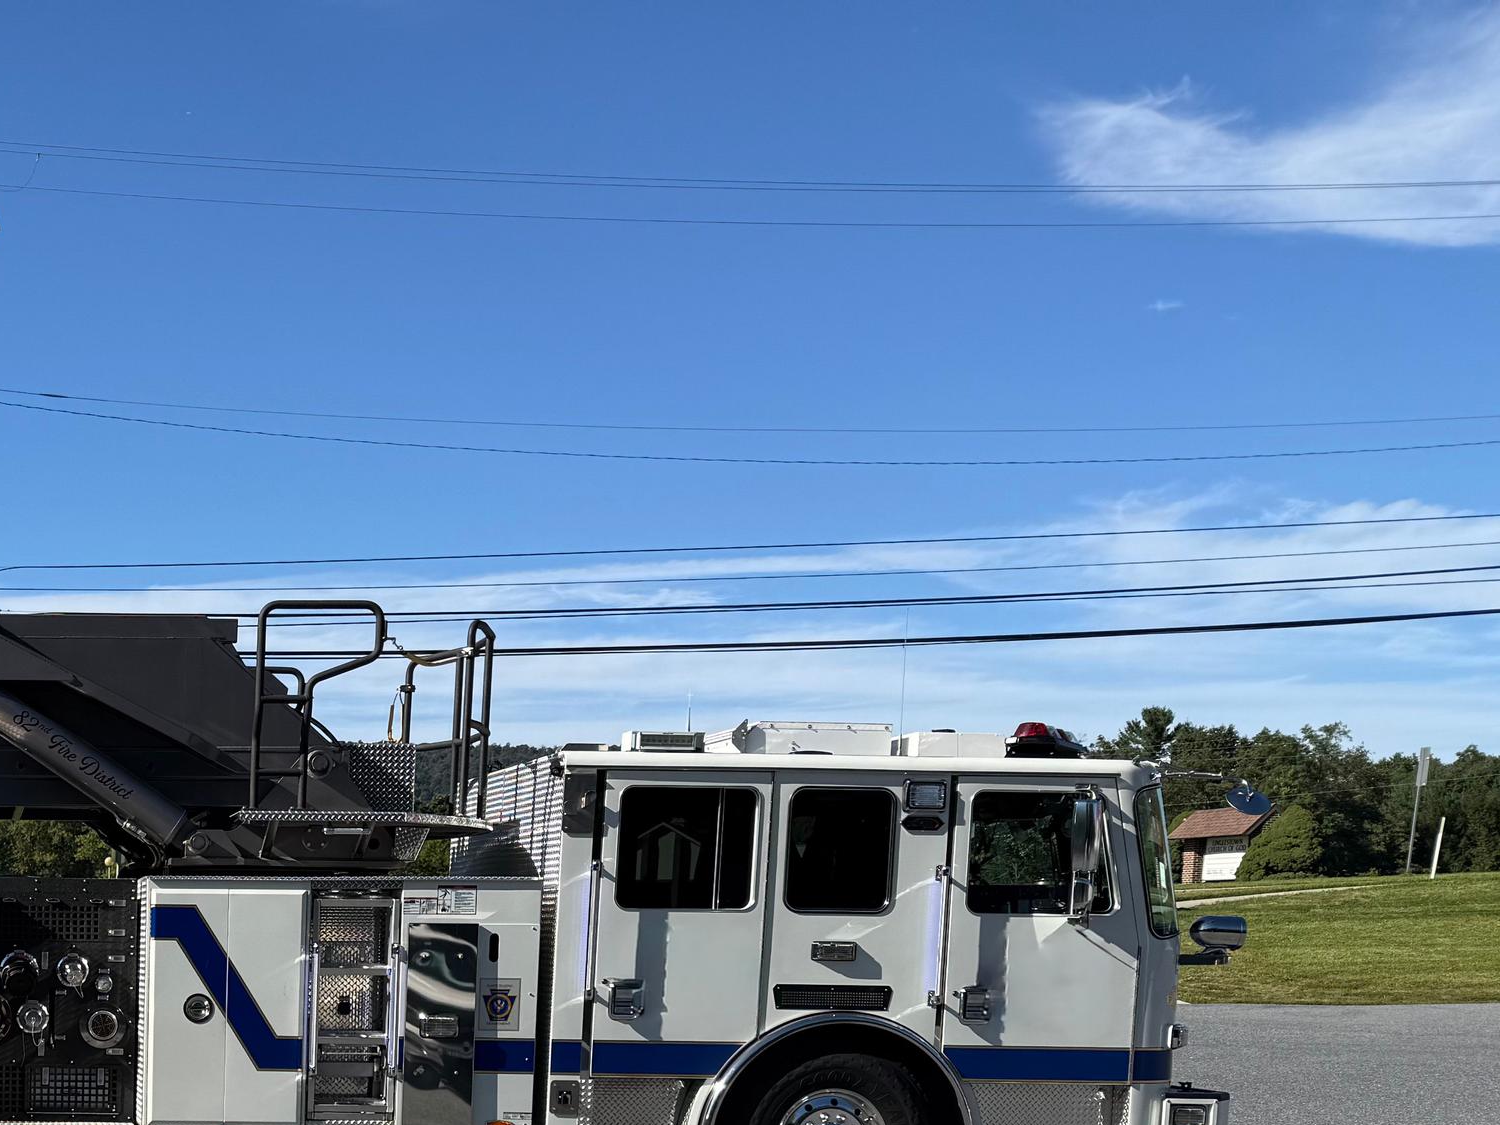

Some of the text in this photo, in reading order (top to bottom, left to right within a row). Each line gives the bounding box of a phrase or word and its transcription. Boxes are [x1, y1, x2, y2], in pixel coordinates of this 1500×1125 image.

[13, 710, 135, 800] 82nd Fire District
